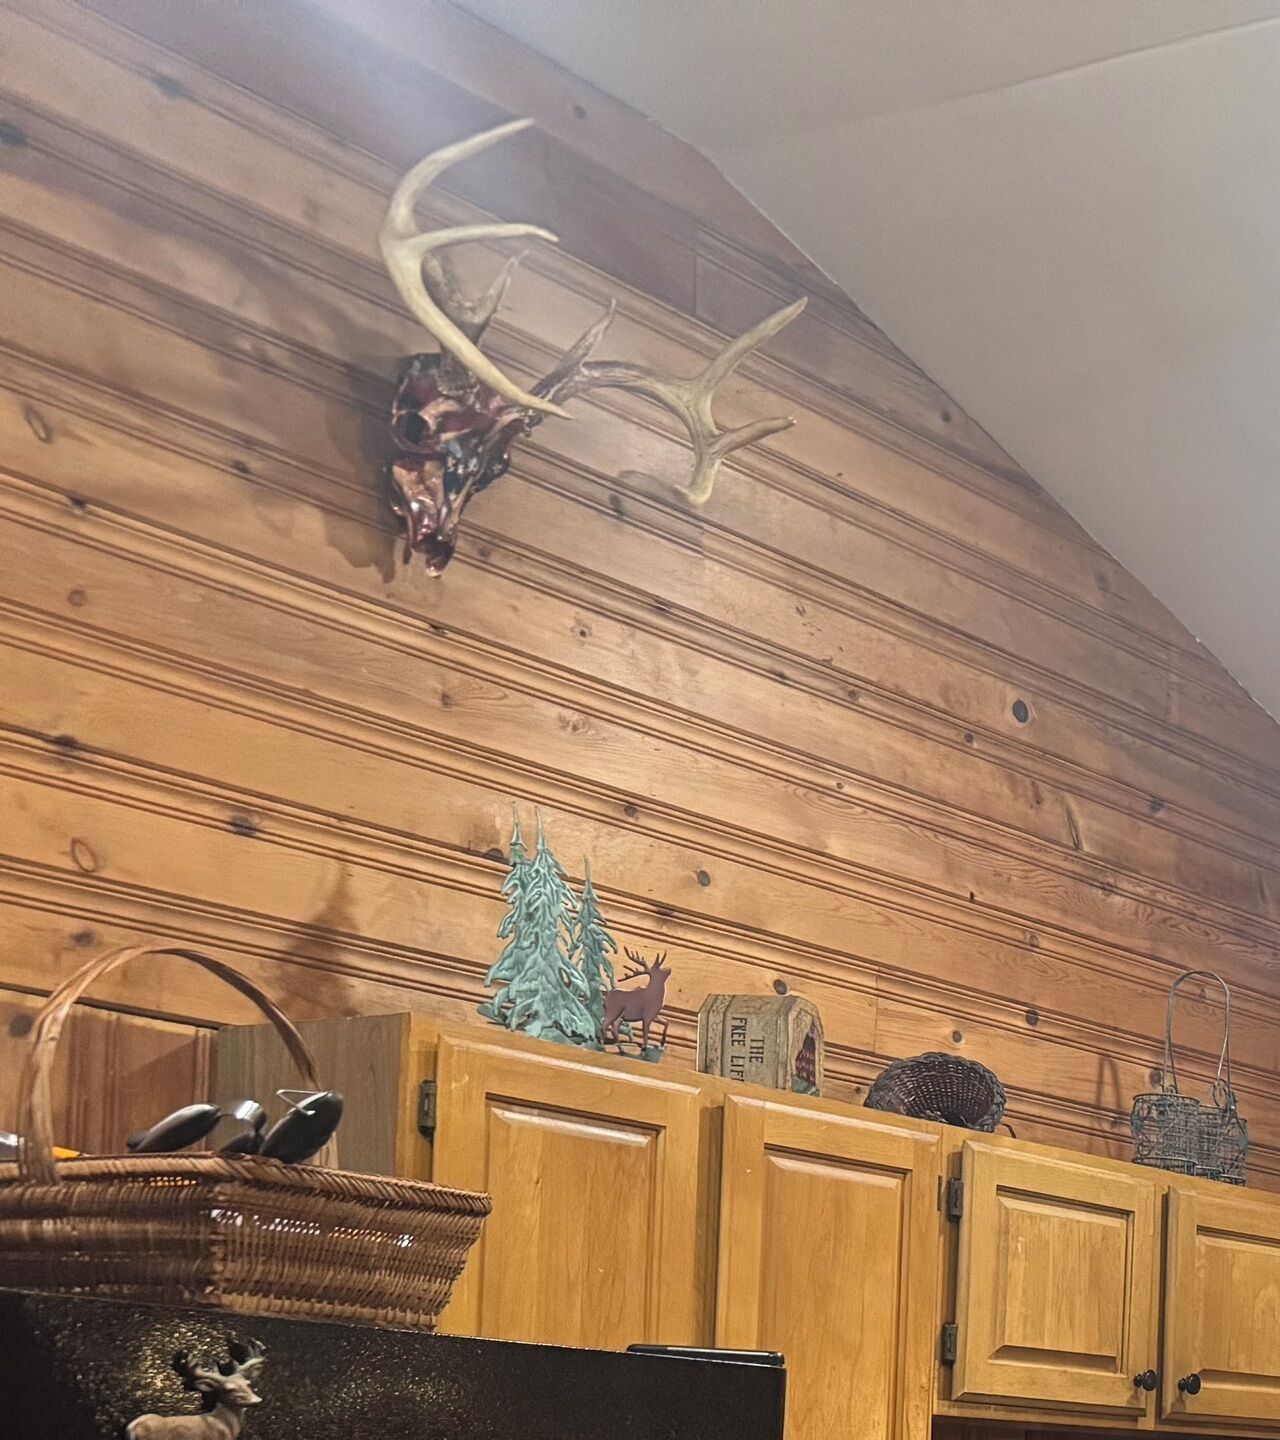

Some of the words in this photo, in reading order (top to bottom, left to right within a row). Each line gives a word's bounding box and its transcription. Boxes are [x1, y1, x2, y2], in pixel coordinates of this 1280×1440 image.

[731, 1016, 747, 1047] FREE
[749, 1037, 765, 1064] THE
[730, 1055, 746, 1082] LIF
